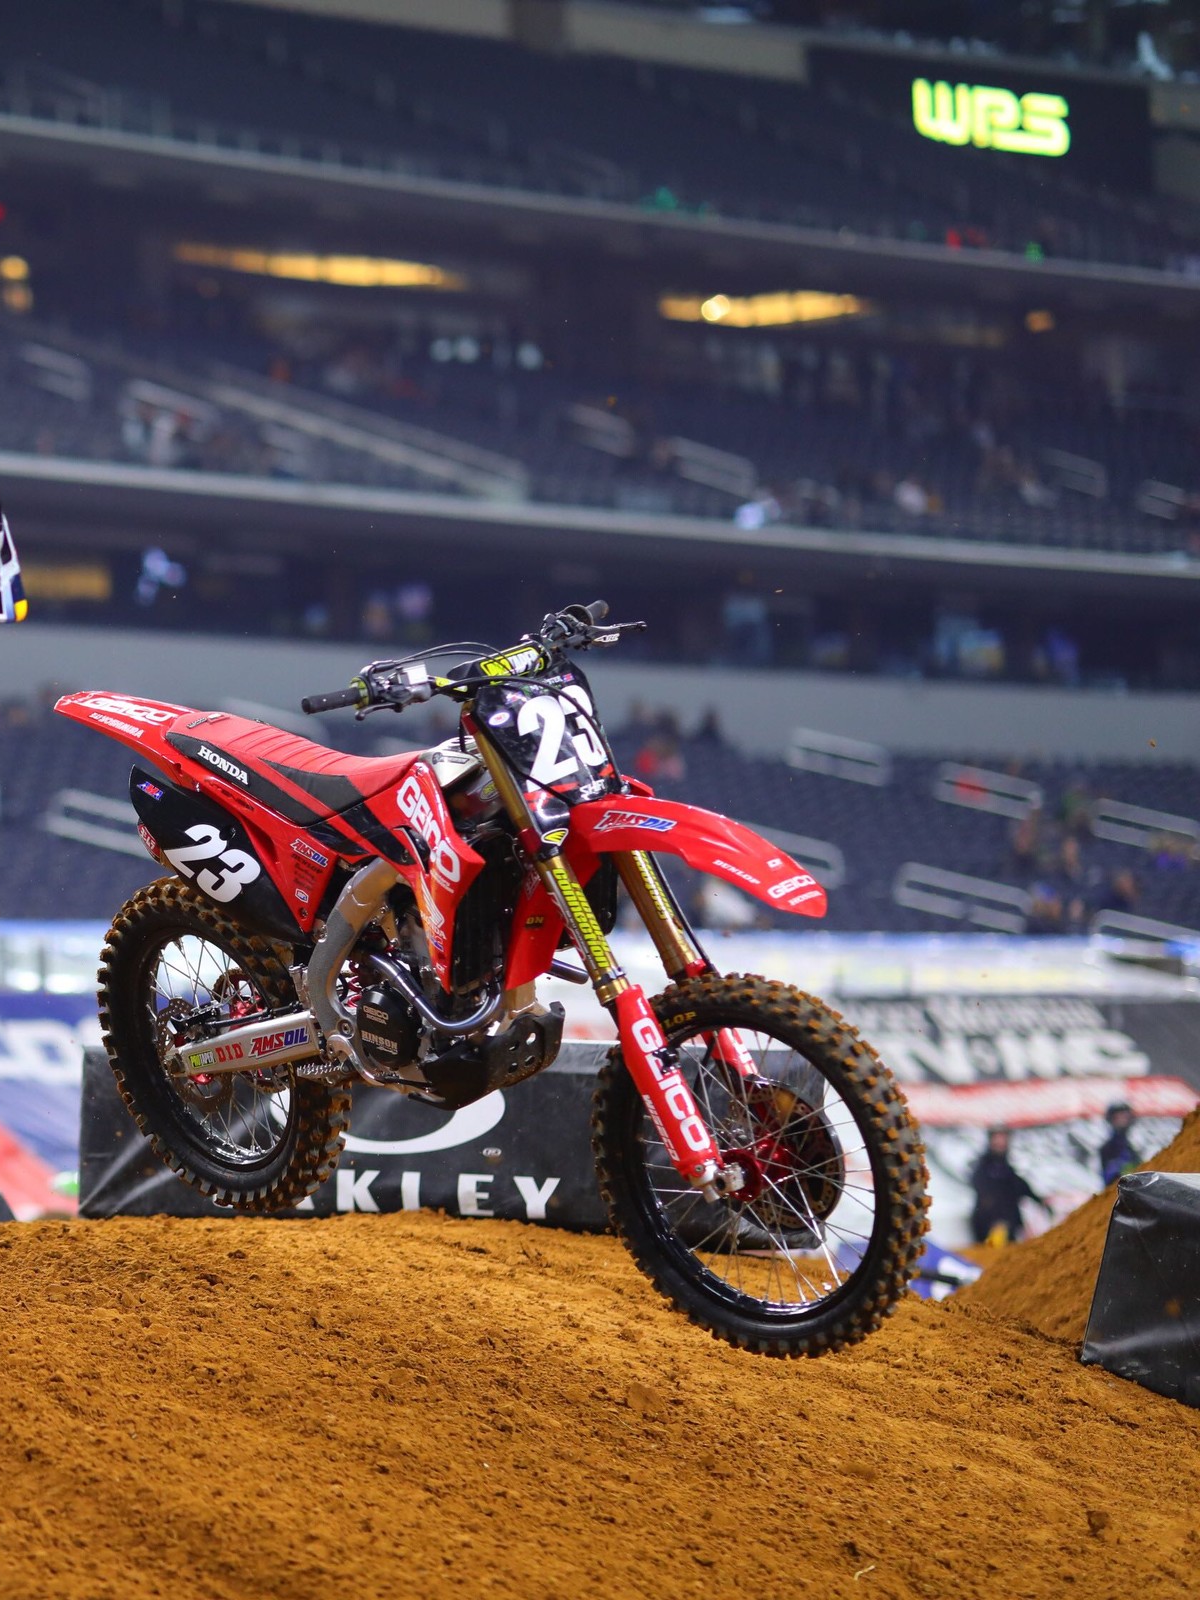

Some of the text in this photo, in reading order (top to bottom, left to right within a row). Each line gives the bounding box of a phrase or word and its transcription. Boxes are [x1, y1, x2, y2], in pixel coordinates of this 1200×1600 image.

[912, 77, 1071, 157] WPS
[517, 684, 609, 792] 23
[198, 745, 248, 785] HONDA
[396, 776, 461, 883] GEICO
[595, 811, 676, 832] AMSOIL
[163, 823, 261, 903] 23
[712, 859, 760, 884] DUNLOP
[766, 874, 816, 899] GEICO
[250, 1027, 310, 1058] AMSOIL
